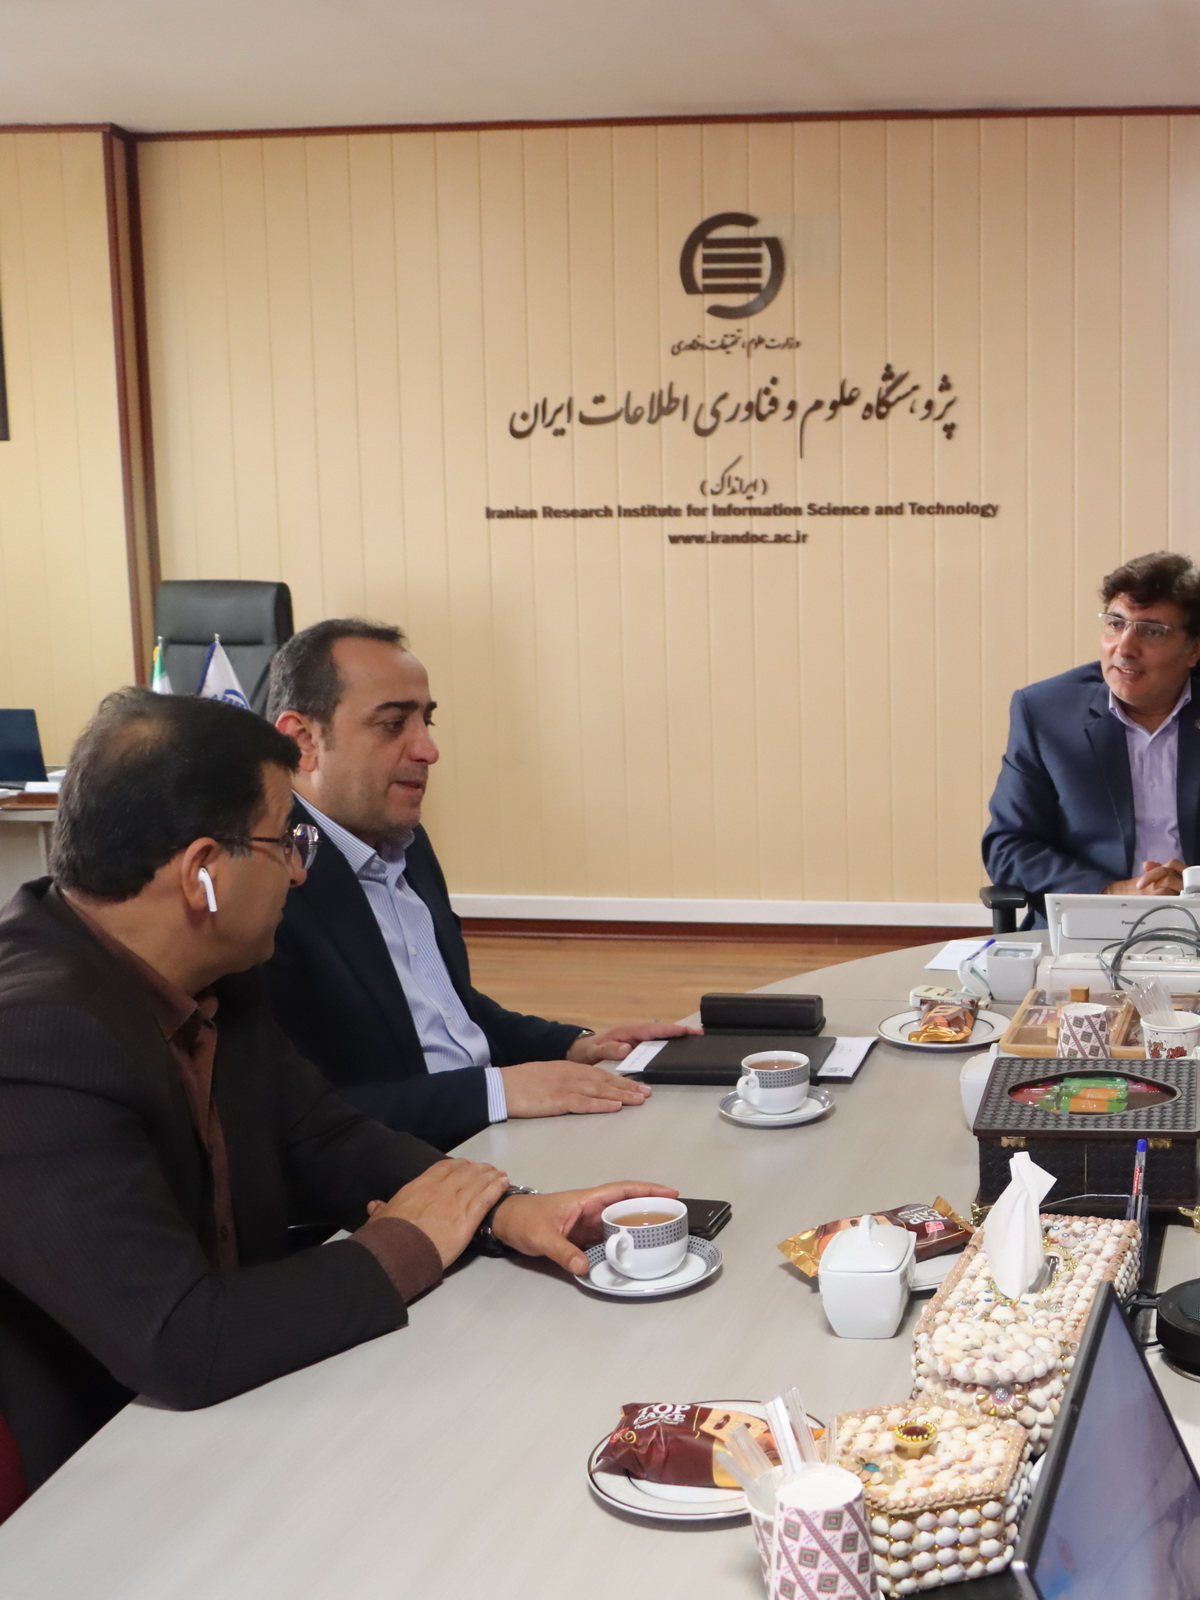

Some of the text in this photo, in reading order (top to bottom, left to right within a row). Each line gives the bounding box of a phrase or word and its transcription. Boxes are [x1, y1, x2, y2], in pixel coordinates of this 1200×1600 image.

[509, 362, 958, 460] پژوهشگاه علوم و فناوری اطلاعات ایران
[485, 501, 999, 519] Iranian Research Institute for Information Science and Technology
[667, 530, 809, 545] www.irandoc.ac.ir
[637, 1402, 691, 1416] TOP
[633, 1411, 686, 1426] CAKE
